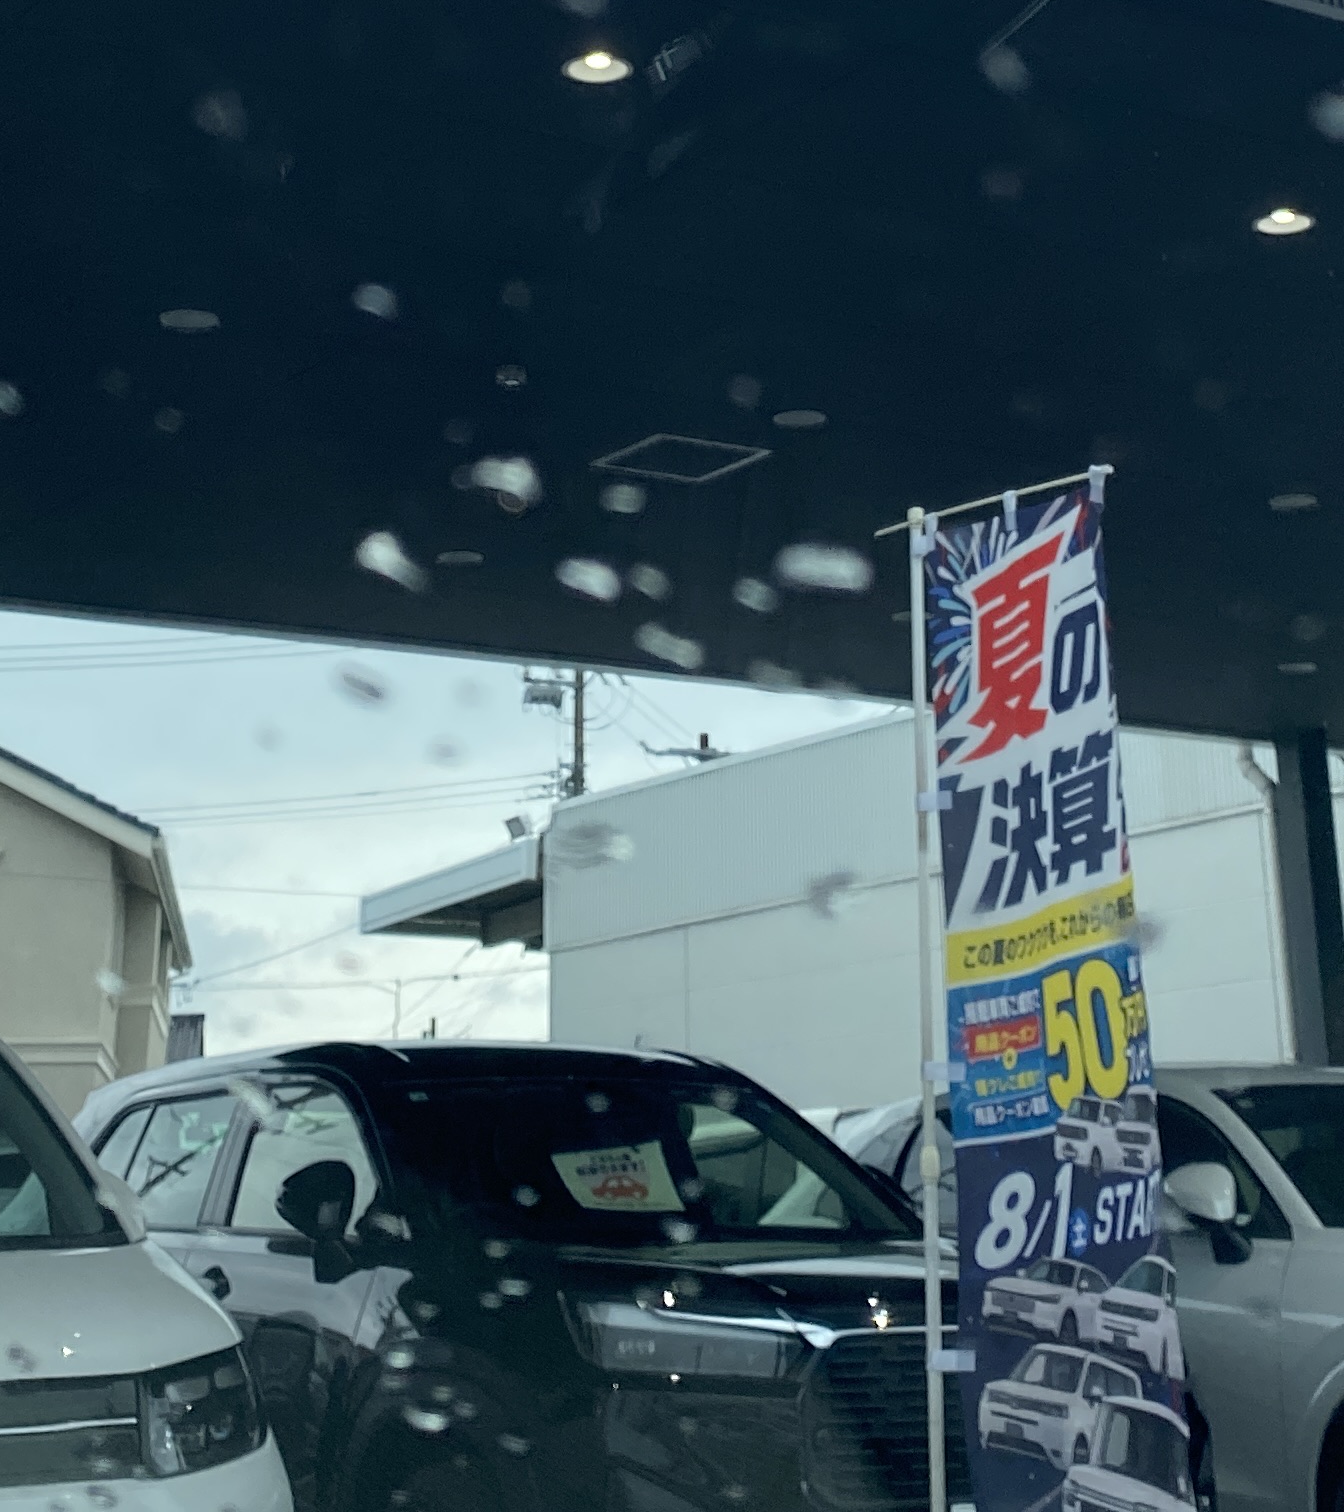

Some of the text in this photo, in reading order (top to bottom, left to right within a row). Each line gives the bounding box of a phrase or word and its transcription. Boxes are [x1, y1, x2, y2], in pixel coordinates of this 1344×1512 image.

[957, 530, 1106, 766] 夏の
[972, 729, 1118, 914] 決算
[1041, 958, 1130, 1111] 50
[974, 1161, 1074, 1270] 8/1
